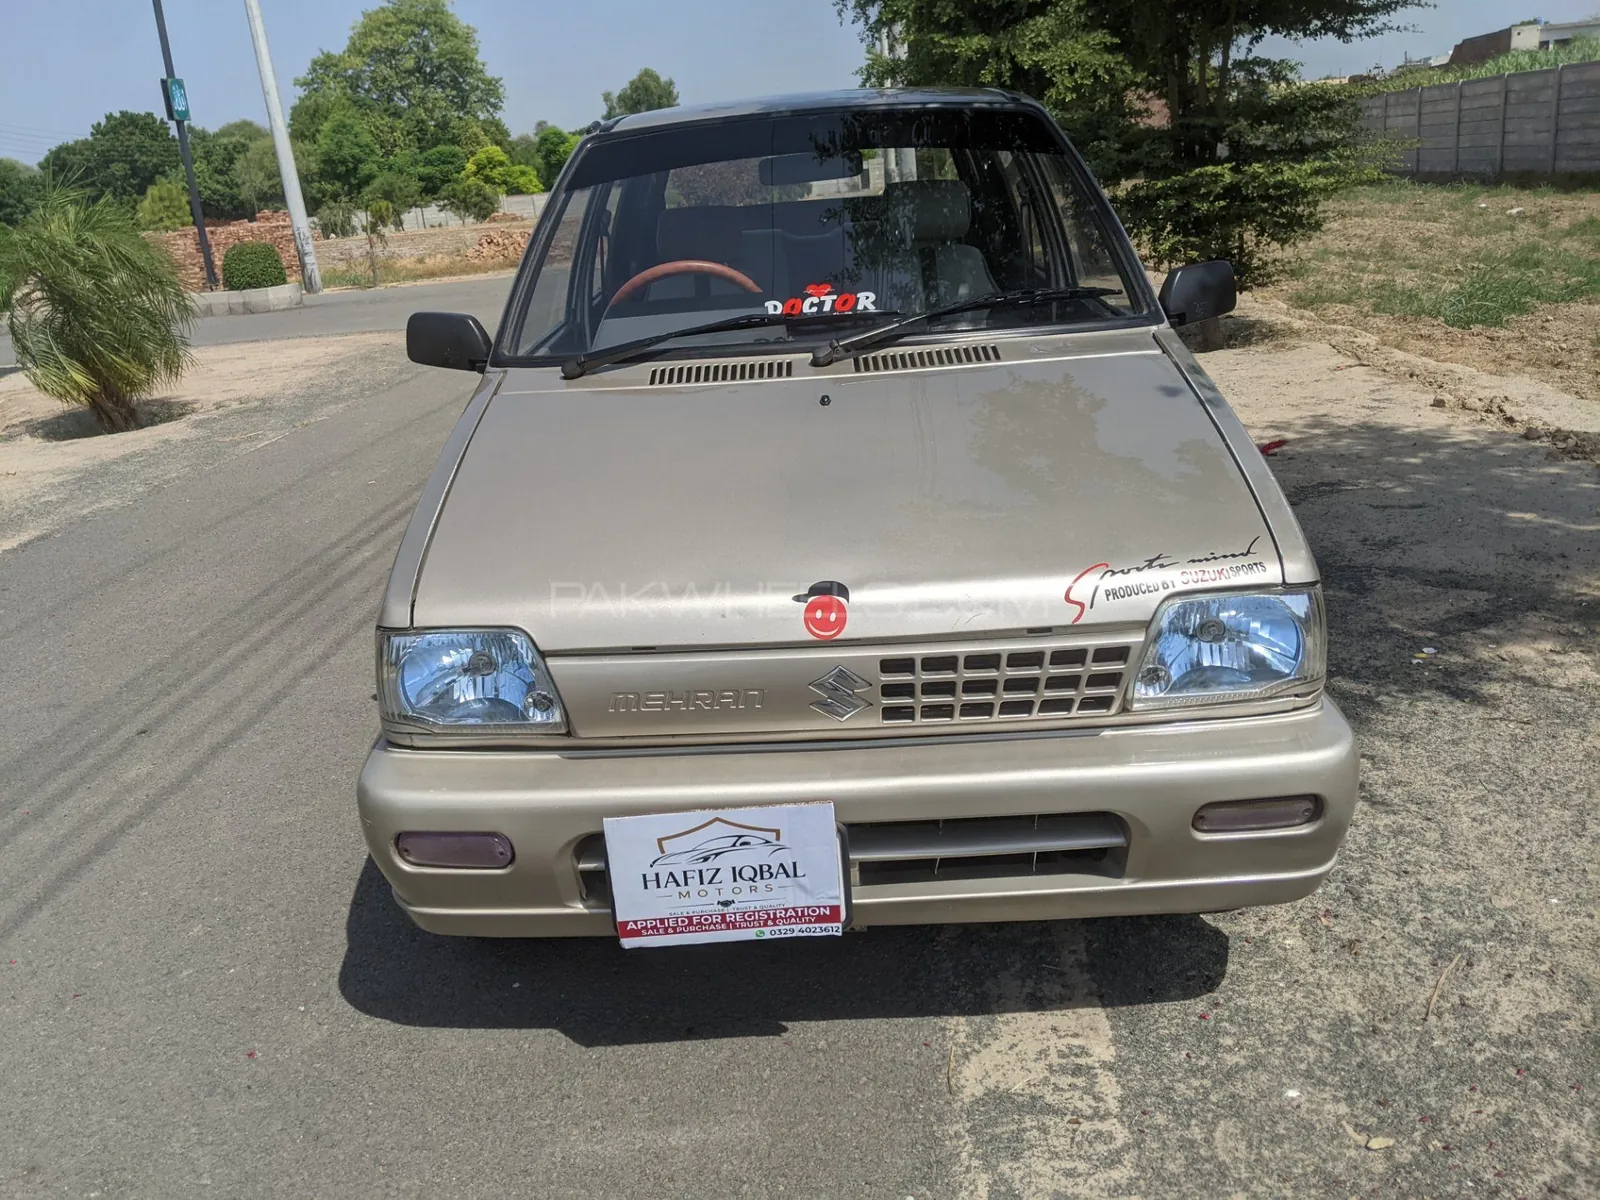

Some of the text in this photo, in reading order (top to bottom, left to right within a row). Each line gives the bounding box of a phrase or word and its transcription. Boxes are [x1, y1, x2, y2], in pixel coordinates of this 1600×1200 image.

[764, 291, 876, 316] DOCTOR
[1104, 581, 1160, 601] PRODUCED
[1161, 578, 1176, 590] BY
[608, 689, 764, 712] MEHRAN
[641, 861, 806, 890] HAFIZ IQBAL
[678, 883, 774, 899] MOTORS
[627, 907, 830, 931] APPLIED FOR REGISTRATION
[677, 924, 726, 932] PURCHASE
[736, 920, 764, 929] TRUST
[776, 917, 816, 925] QUALITY
[769, 925, 841, 937] 0329 4023612
